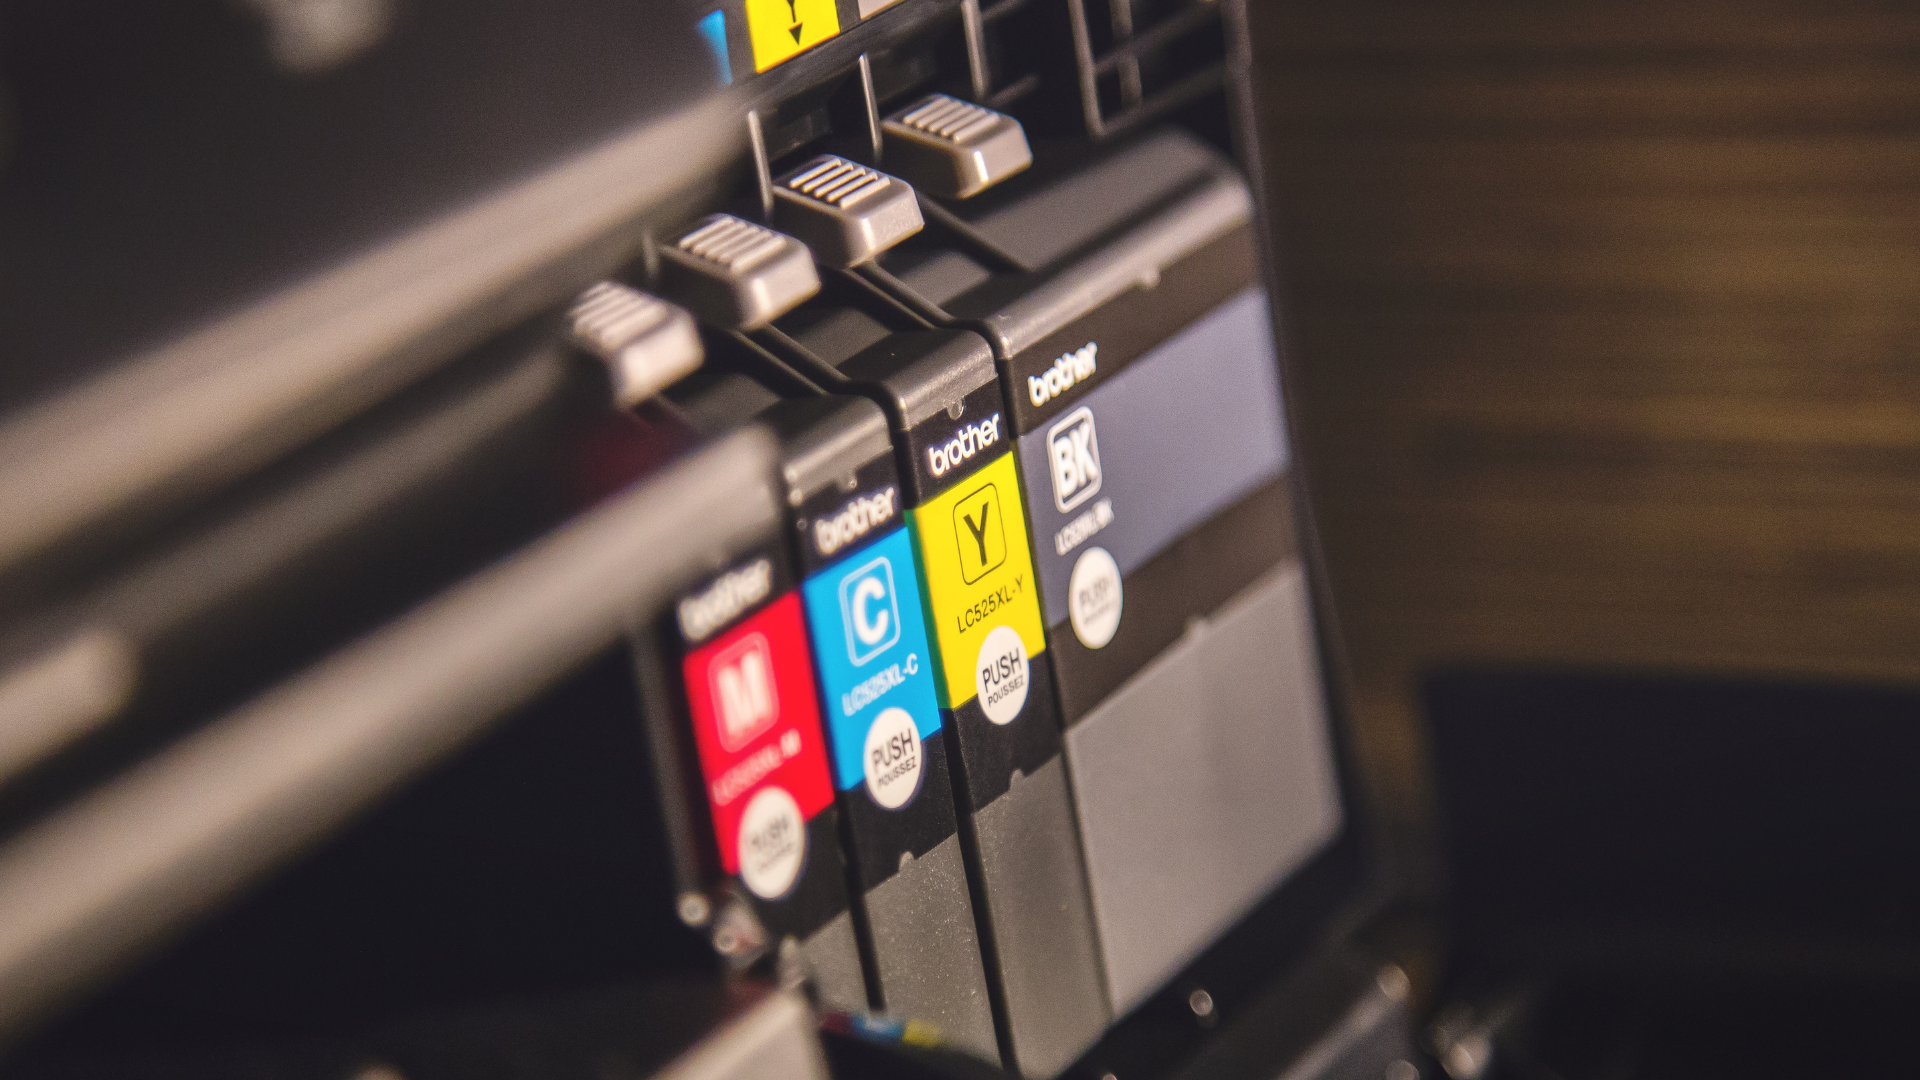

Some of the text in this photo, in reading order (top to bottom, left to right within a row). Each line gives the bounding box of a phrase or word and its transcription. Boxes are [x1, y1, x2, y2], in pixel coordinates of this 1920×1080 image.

[1027, 341, 1098, 407] brother
[928, 412, 1000, 478] brother
[1054, 421, 1099, 499] BK
[814, 485, 895, 555] brother
[962, 501, 990, 568] Y
[852, 576, 890, 646] C
[956, 574, 1024, 635] LC525XL-Y
[716, 649, 771, 738] M
[981, 647, 1022, 694] PUSH
[987, 674, 1025, 708] POUSSEZ
[871, 727, 915, 776] PUSH
[878, 755, 917, 789] POUSSEZ
